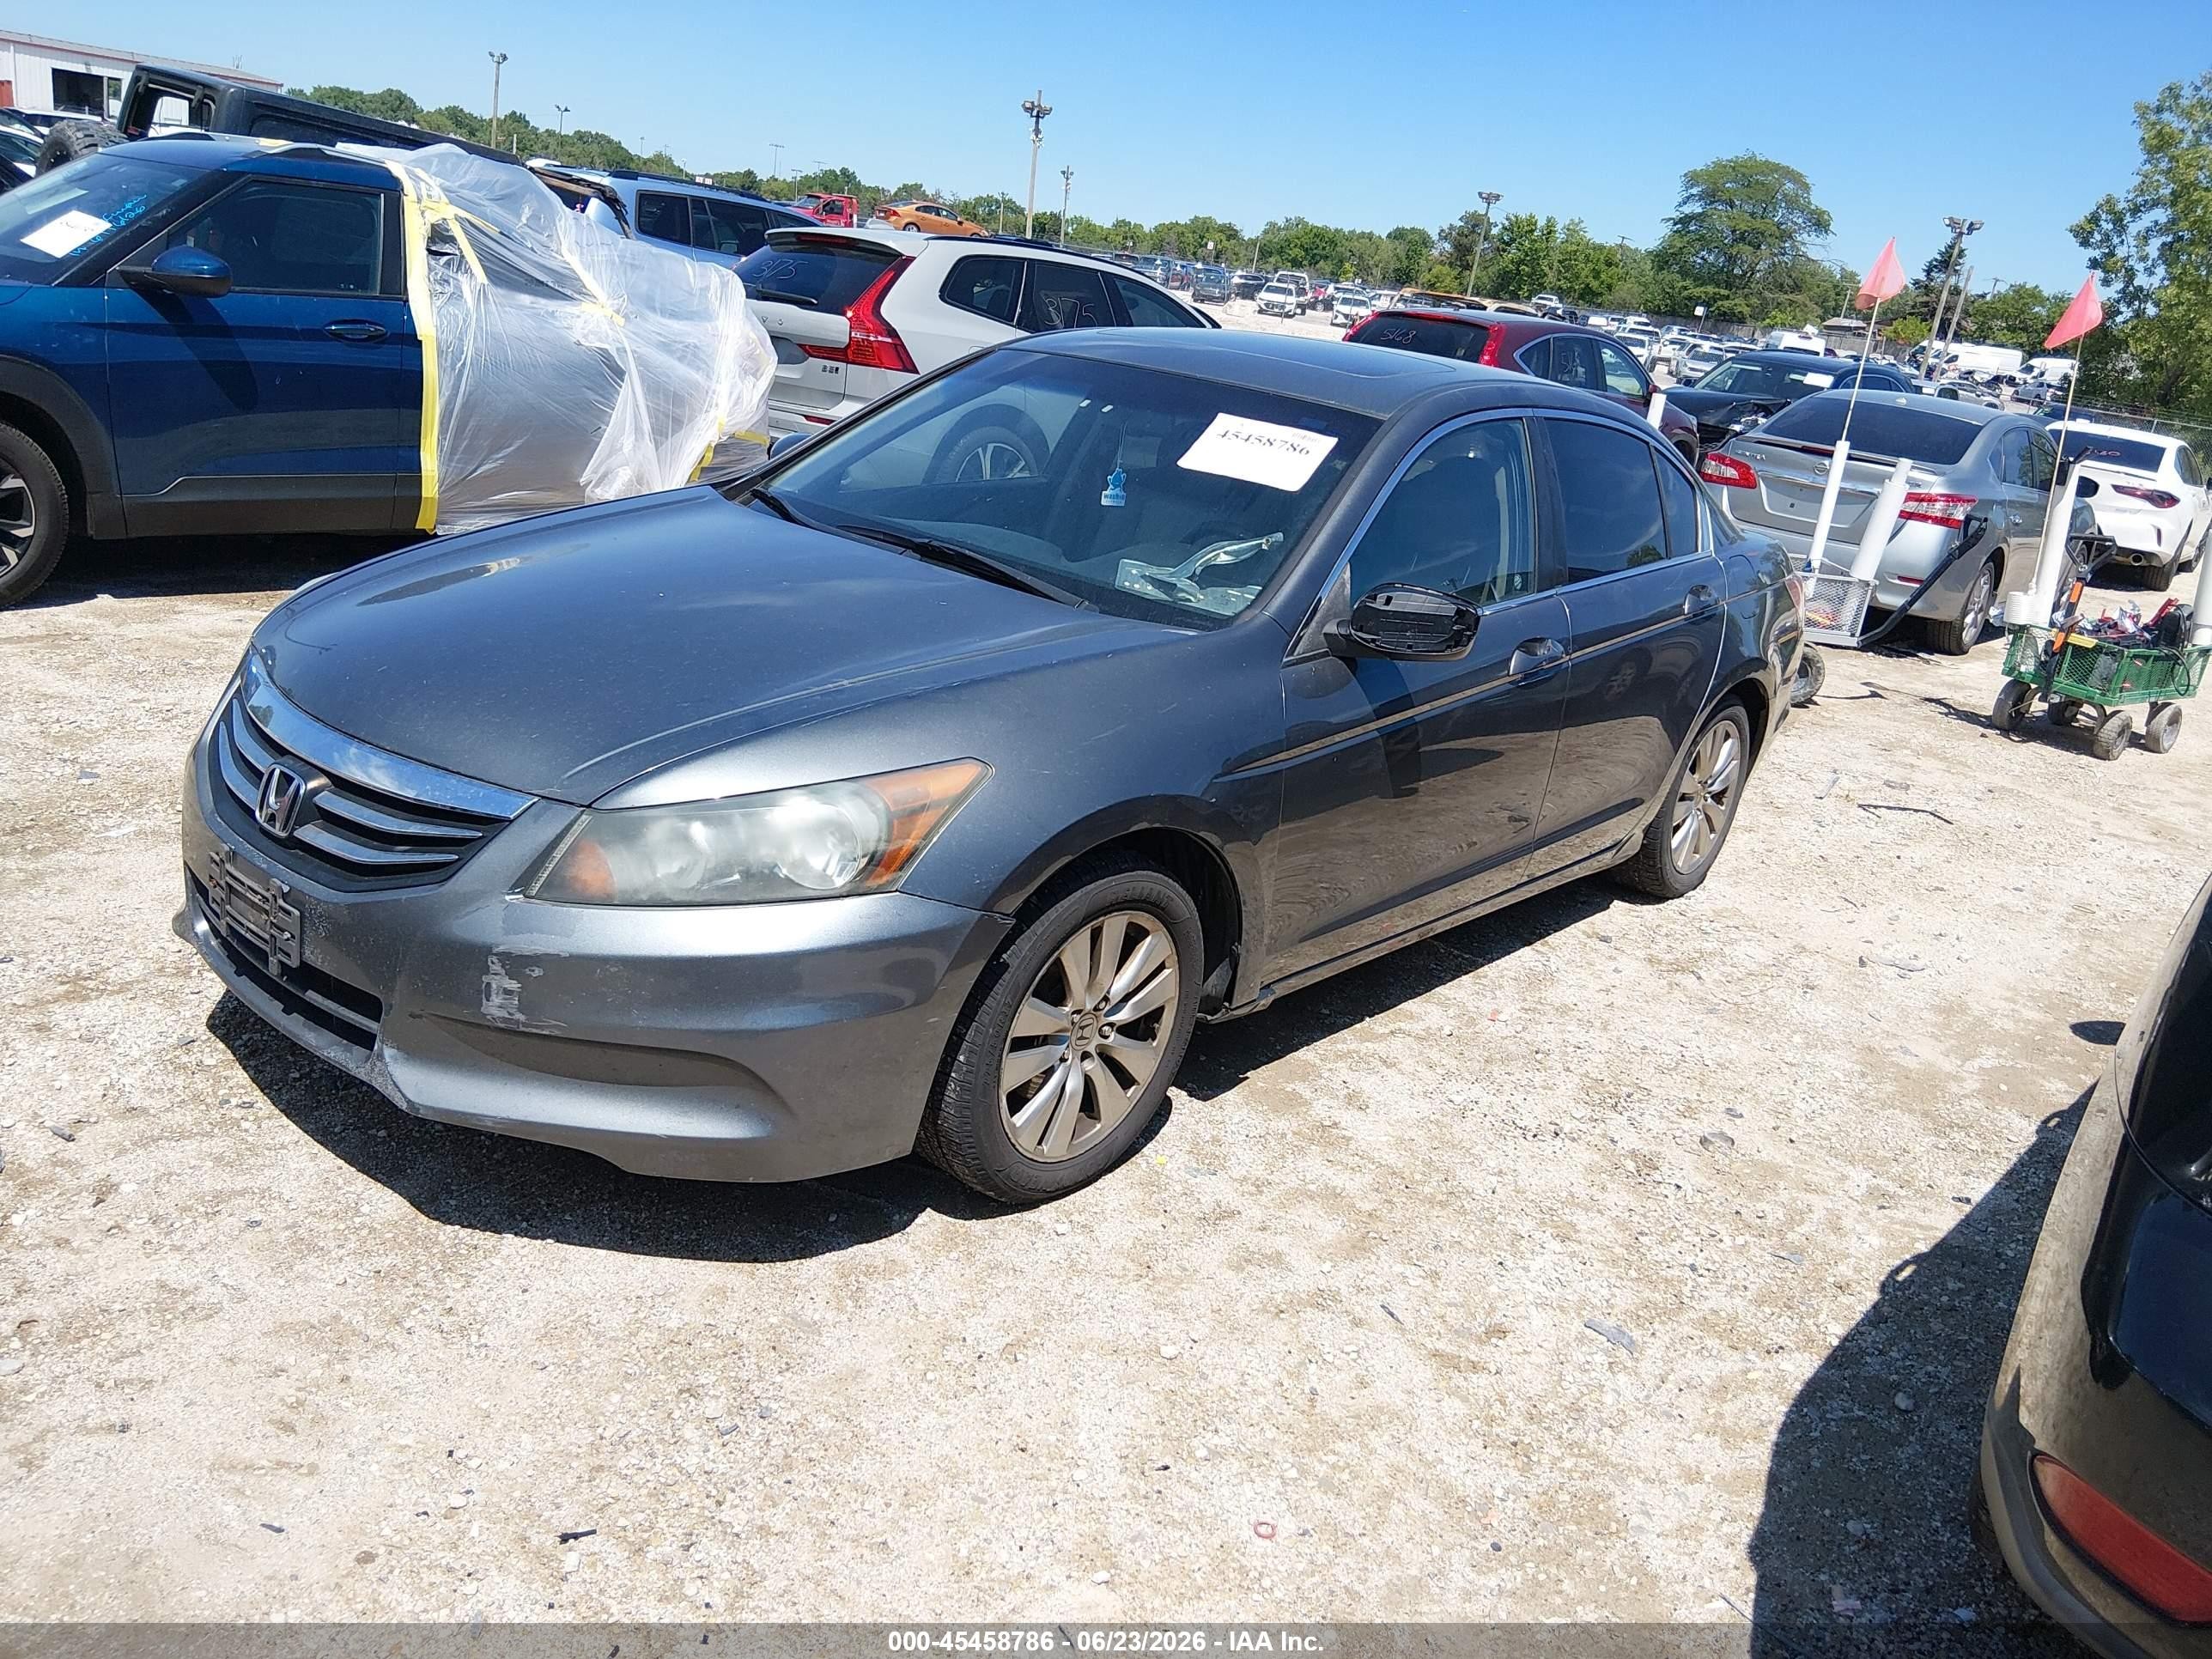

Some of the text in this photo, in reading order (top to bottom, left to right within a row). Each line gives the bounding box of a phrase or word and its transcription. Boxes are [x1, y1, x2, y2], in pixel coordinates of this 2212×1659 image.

[752, 258, 810, 279] 3175
[1044, 297, 1098, 330] 3175
[1380, 328, 1417, 343] 5168
[1216, 429, 1310, 456] 45458786
